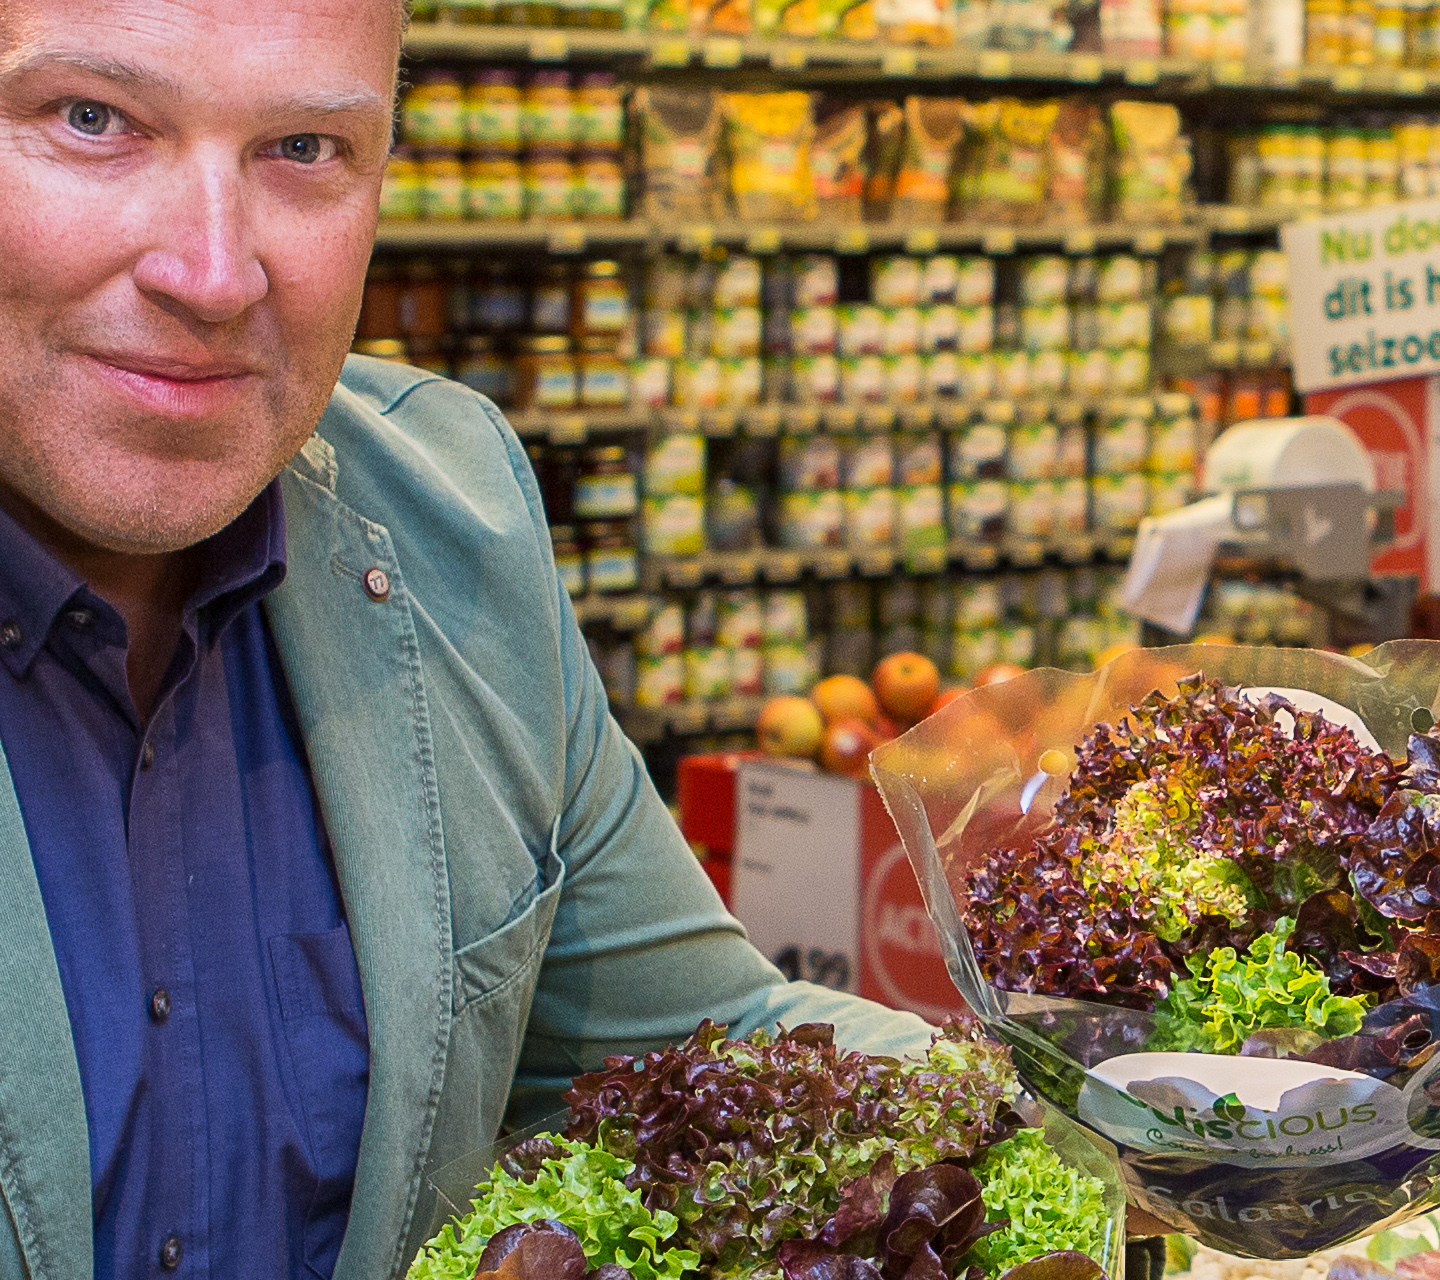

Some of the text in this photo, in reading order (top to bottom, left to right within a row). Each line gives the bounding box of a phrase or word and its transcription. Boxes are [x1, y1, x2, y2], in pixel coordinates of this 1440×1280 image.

[1319, 226, 1373, 268] Nu
[1323, 273, 1373, 321] dit
[1385, 269, 1413, 311] is
